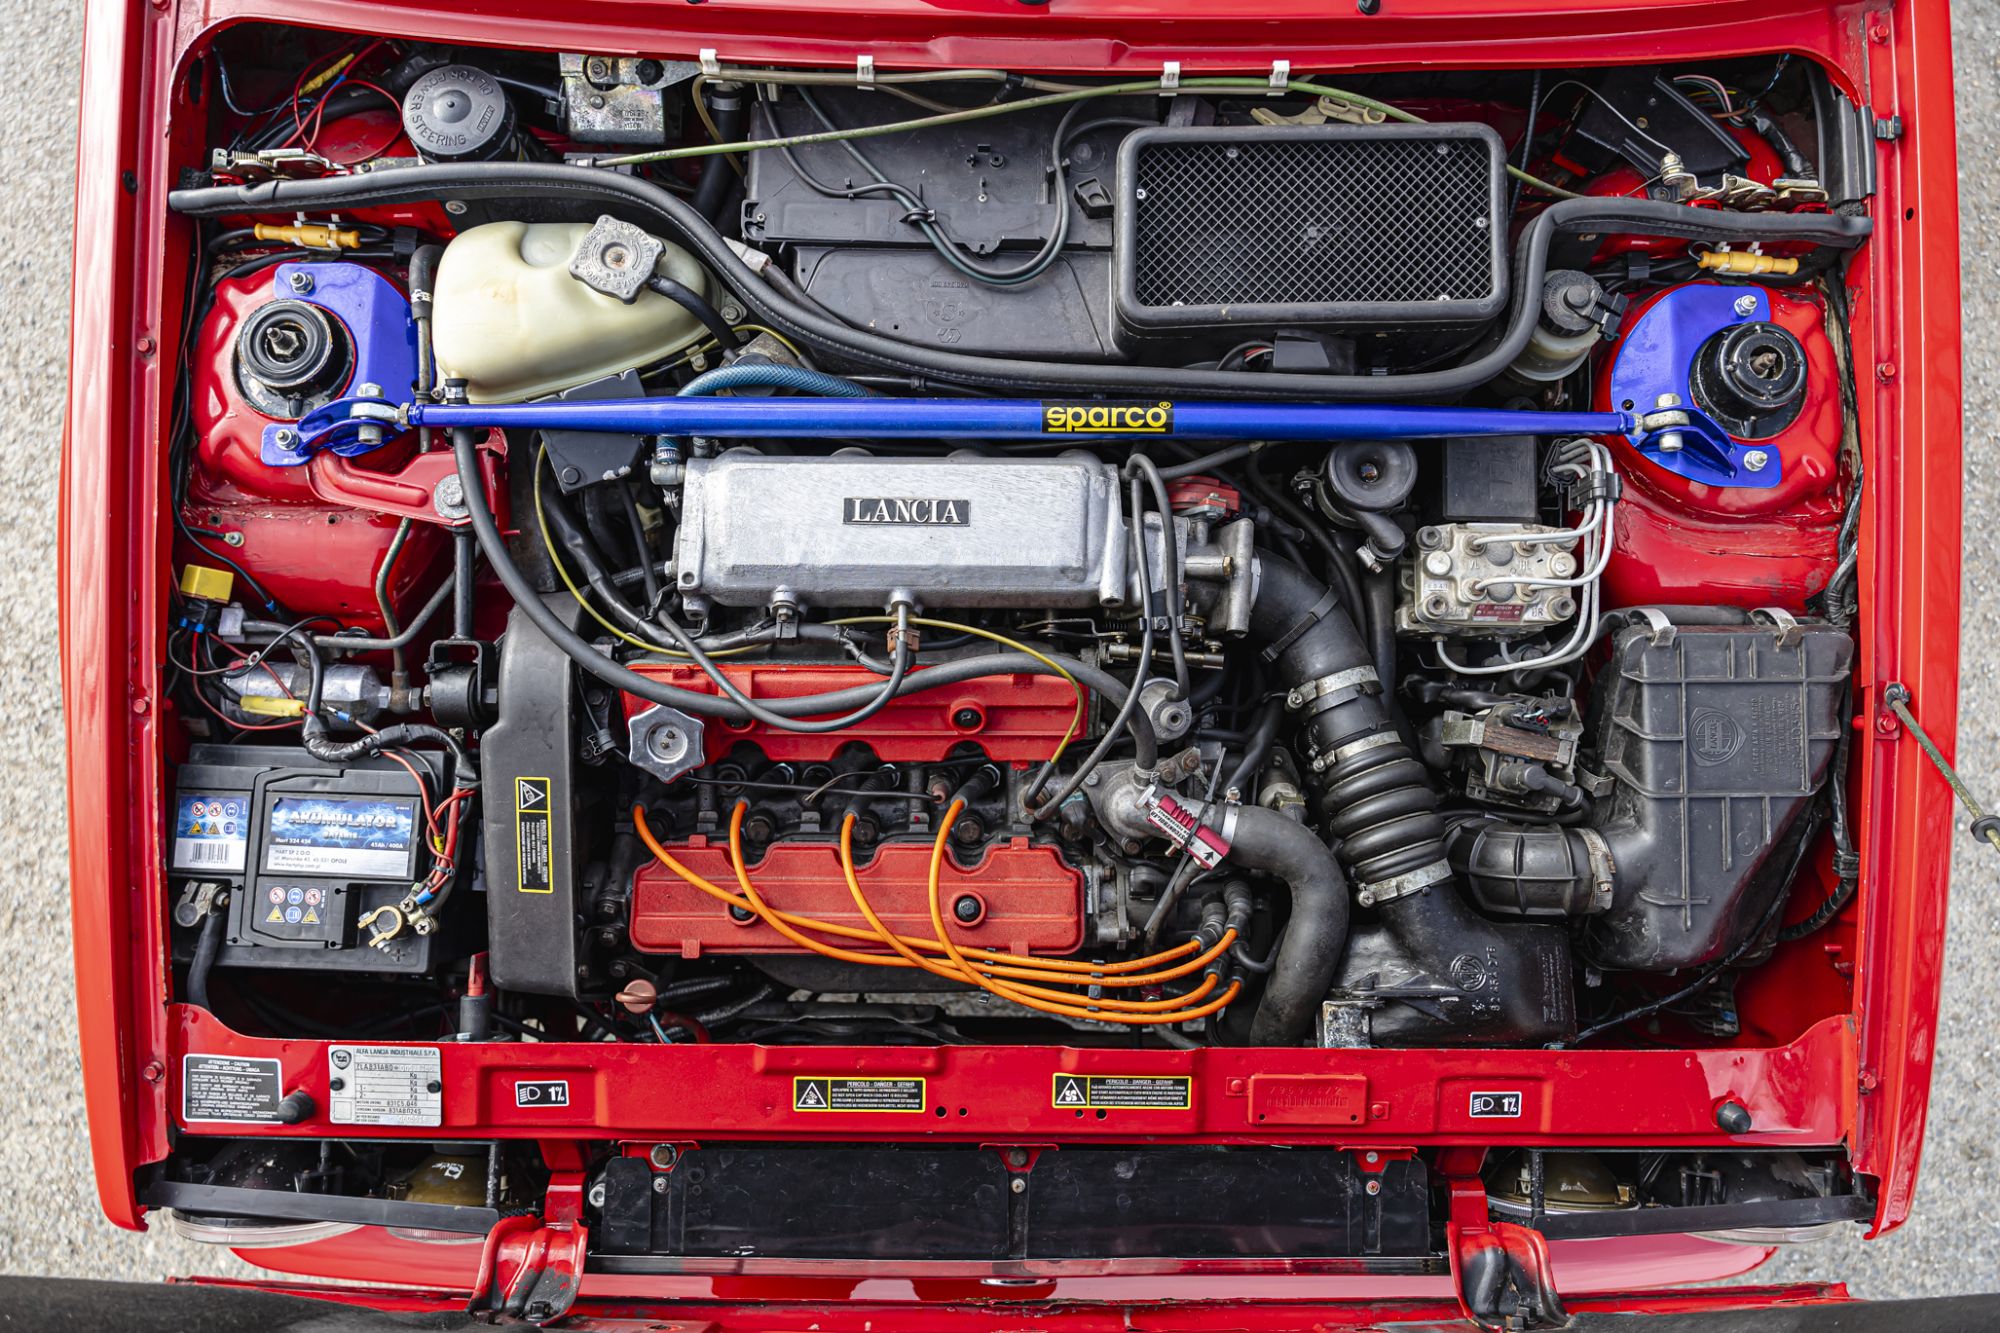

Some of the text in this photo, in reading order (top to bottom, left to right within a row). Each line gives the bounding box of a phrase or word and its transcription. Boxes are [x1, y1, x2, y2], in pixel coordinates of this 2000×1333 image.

[450, 71, 475, 83] FOR
[410, 73, 447, 111] POWER
[479, 79, 494, 96] OIL
[412, 114, 467, 146] STEERING
[850, 500, 961, 525] LANCIA
[1709, 721, 1718, 750] LANCIA
[288, 810, 398, 828] AKUMULATOR
[549, 1085, 566, 1102] 1%
[1502, 1096, 1519, 1113] 1%
